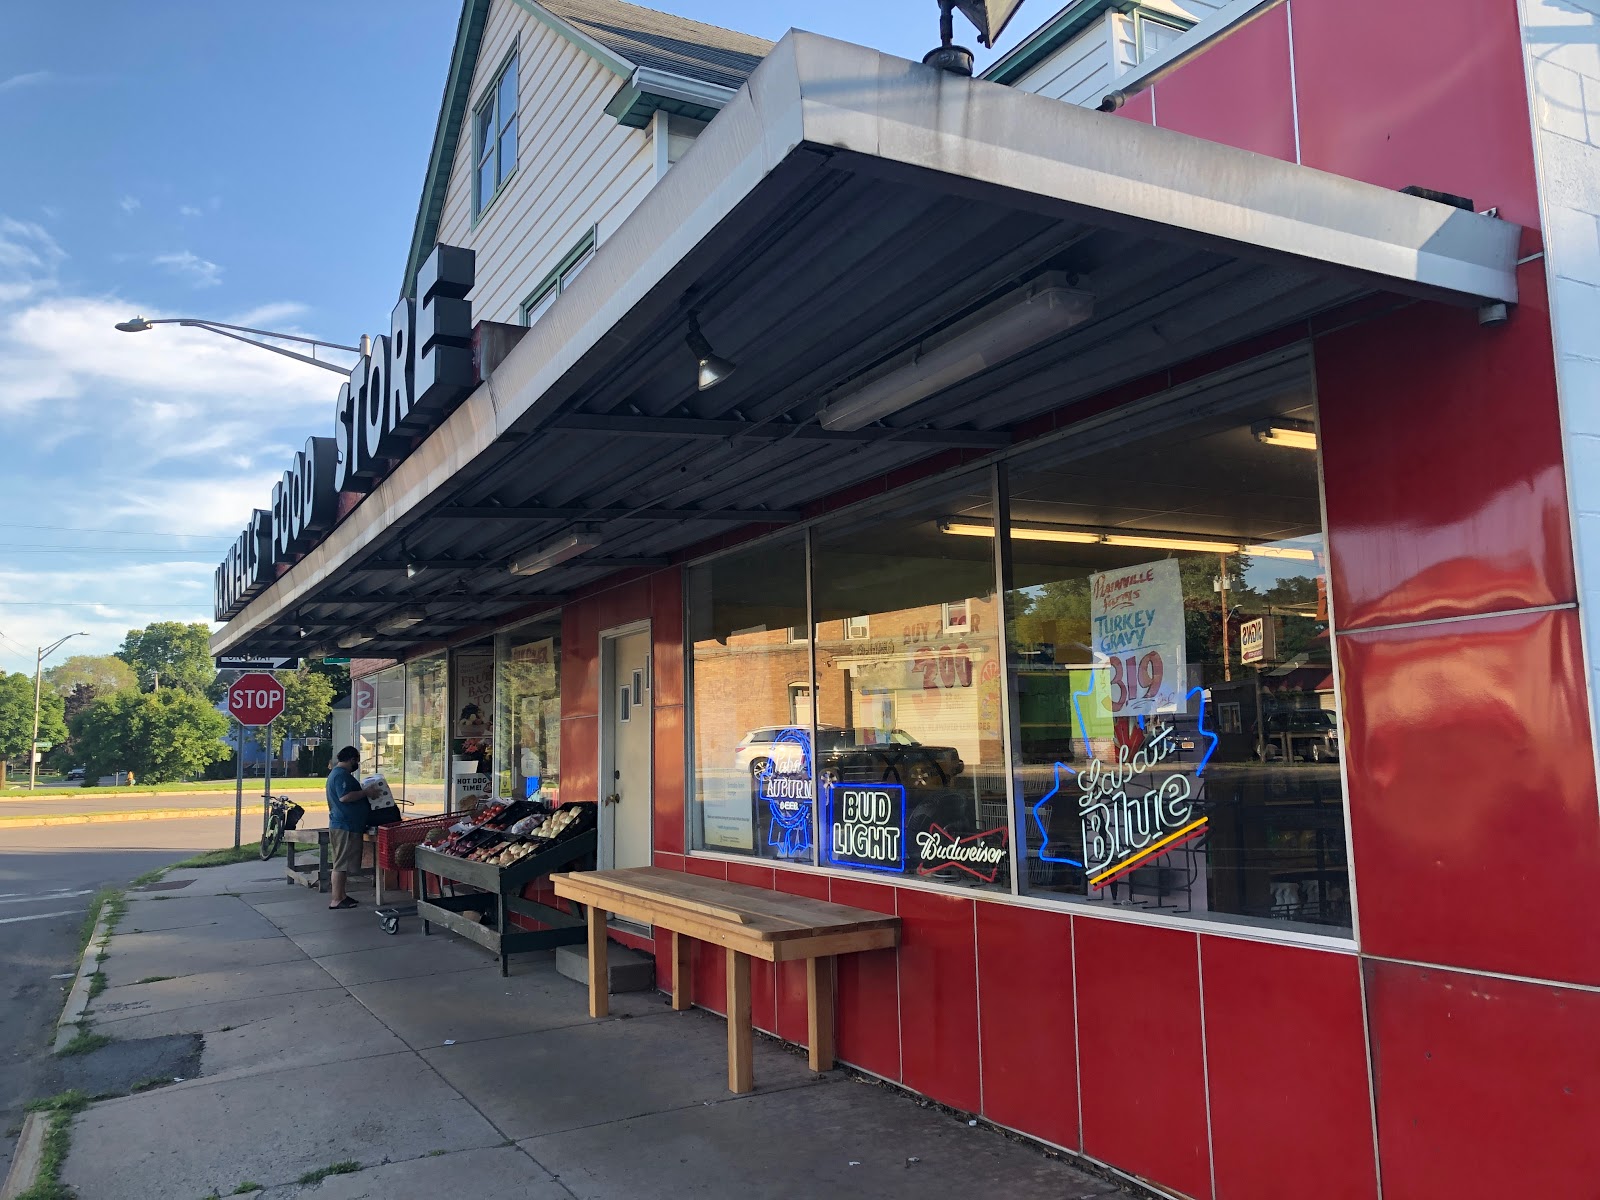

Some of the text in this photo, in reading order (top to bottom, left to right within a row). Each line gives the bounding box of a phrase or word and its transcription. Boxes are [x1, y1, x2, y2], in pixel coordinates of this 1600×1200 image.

[271, 436, 320, 565] FOOD
[334, 242, 444, 493] STORE
[903, 622, 930, 645] BUY
[1094, 608, 1156, 638] TURKEY
[1100, 627, 1147, 652] GRAVY
[231, 689, 281, 709] STOP
[775, 747, 805, 774] Pabst
[1077, 722, 1175, 807] Labatt
[843, 791, 892, 825] BUD
[1078, 773, 1193, 876] Blue
[832, 822, 900, 861] LIGHT
[916, 831, 1006, 864] Budweiser
